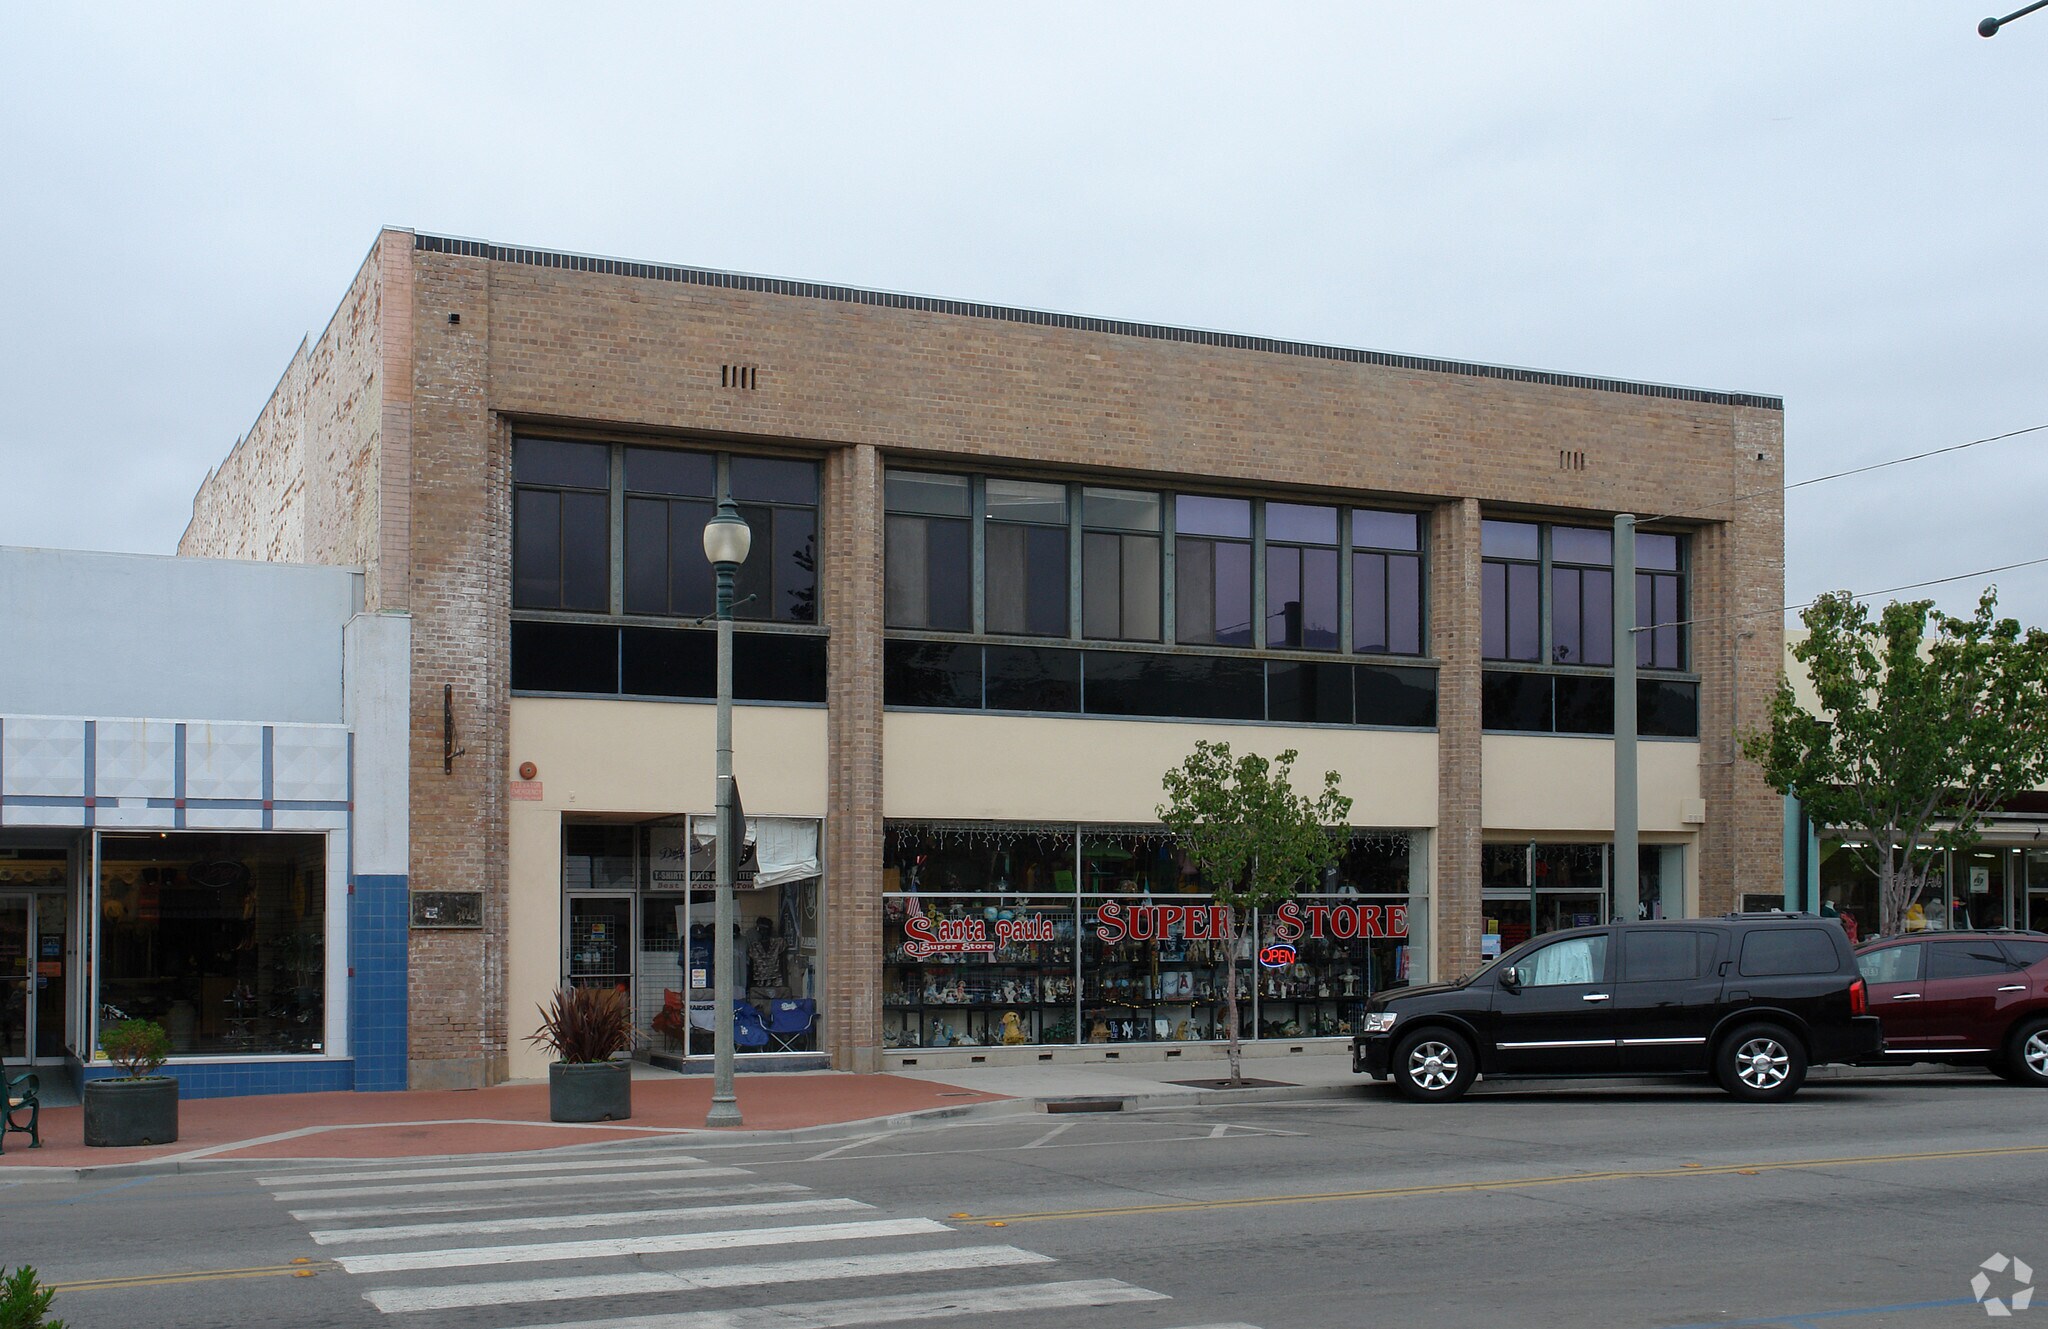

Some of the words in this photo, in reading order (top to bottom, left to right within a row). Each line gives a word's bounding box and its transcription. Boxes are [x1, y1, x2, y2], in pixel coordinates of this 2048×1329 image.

[692, 871, 710, 880] HATS
[903, 911, 986, 963] Santa
[920, 942, 957, 951] Super
[961, 942, 994, 951] Store
[1260, 948, 1296, 964] OPEN
[1122, 1021, 1134, 1039] NY
